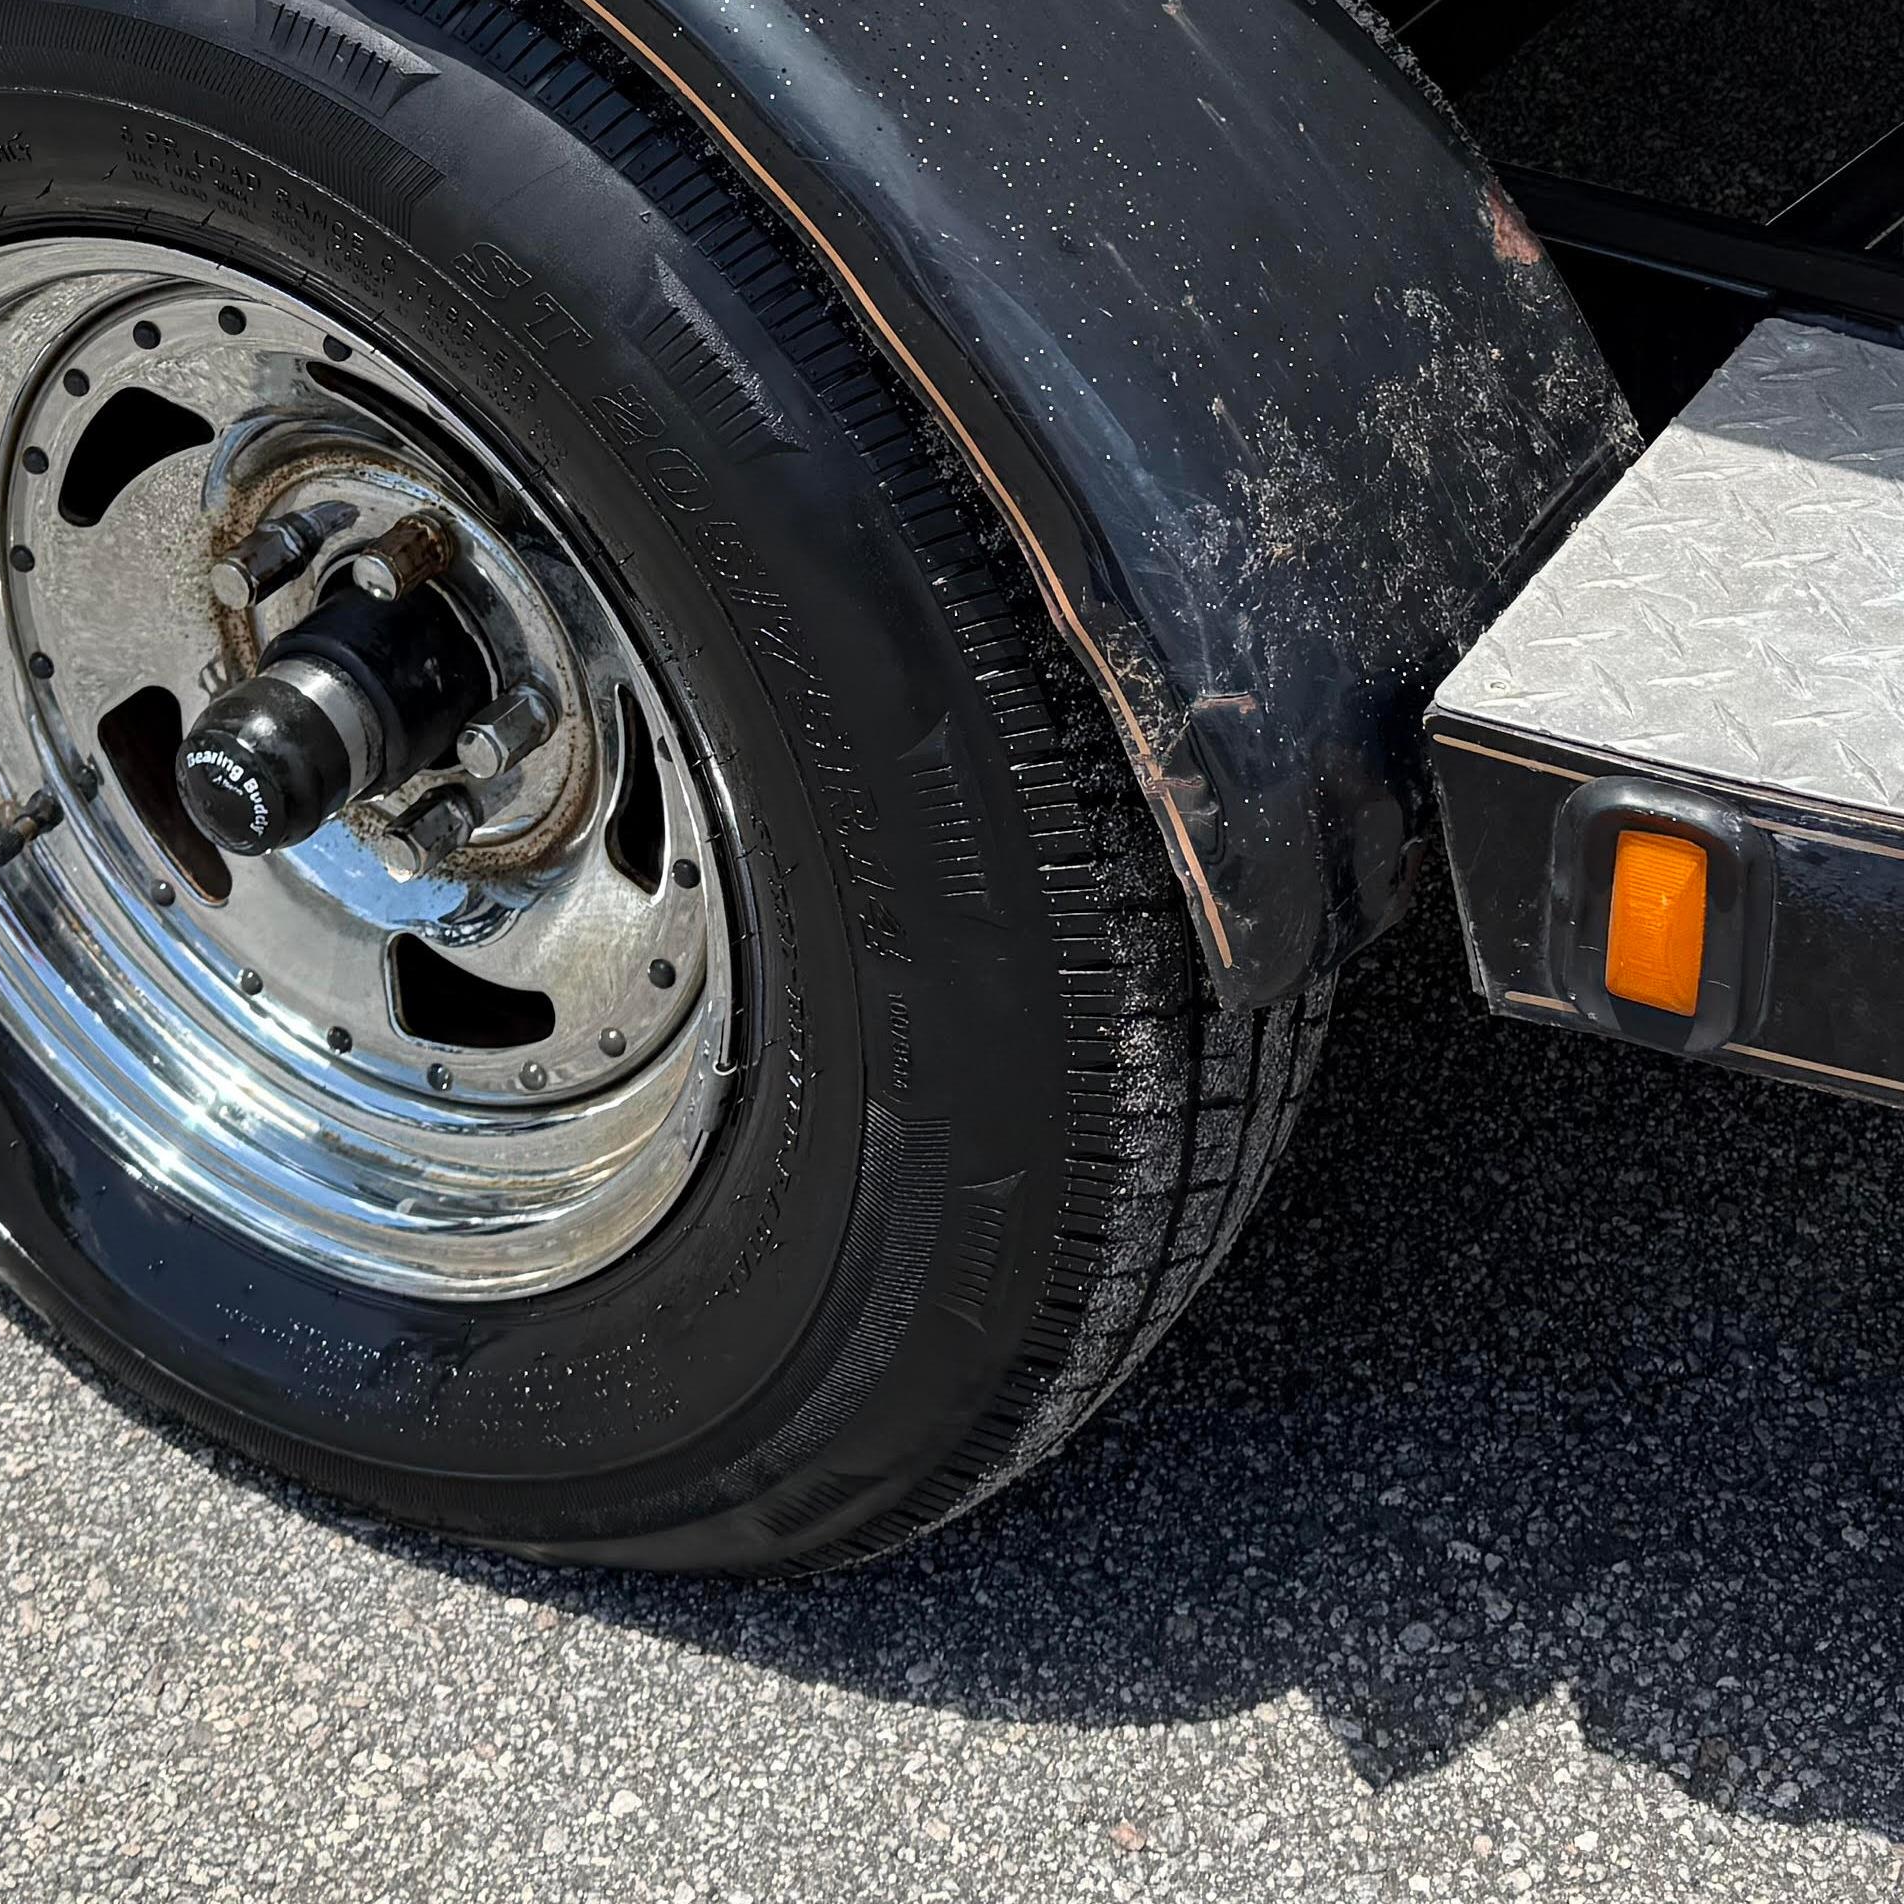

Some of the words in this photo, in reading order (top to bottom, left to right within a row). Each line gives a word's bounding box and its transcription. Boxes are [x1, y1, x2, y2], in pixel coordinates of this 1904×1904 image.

[450, 241, 595, 351] ST
[186, 750, 245, 782] Bearing
[243, 777, 269, 837] Buddy
